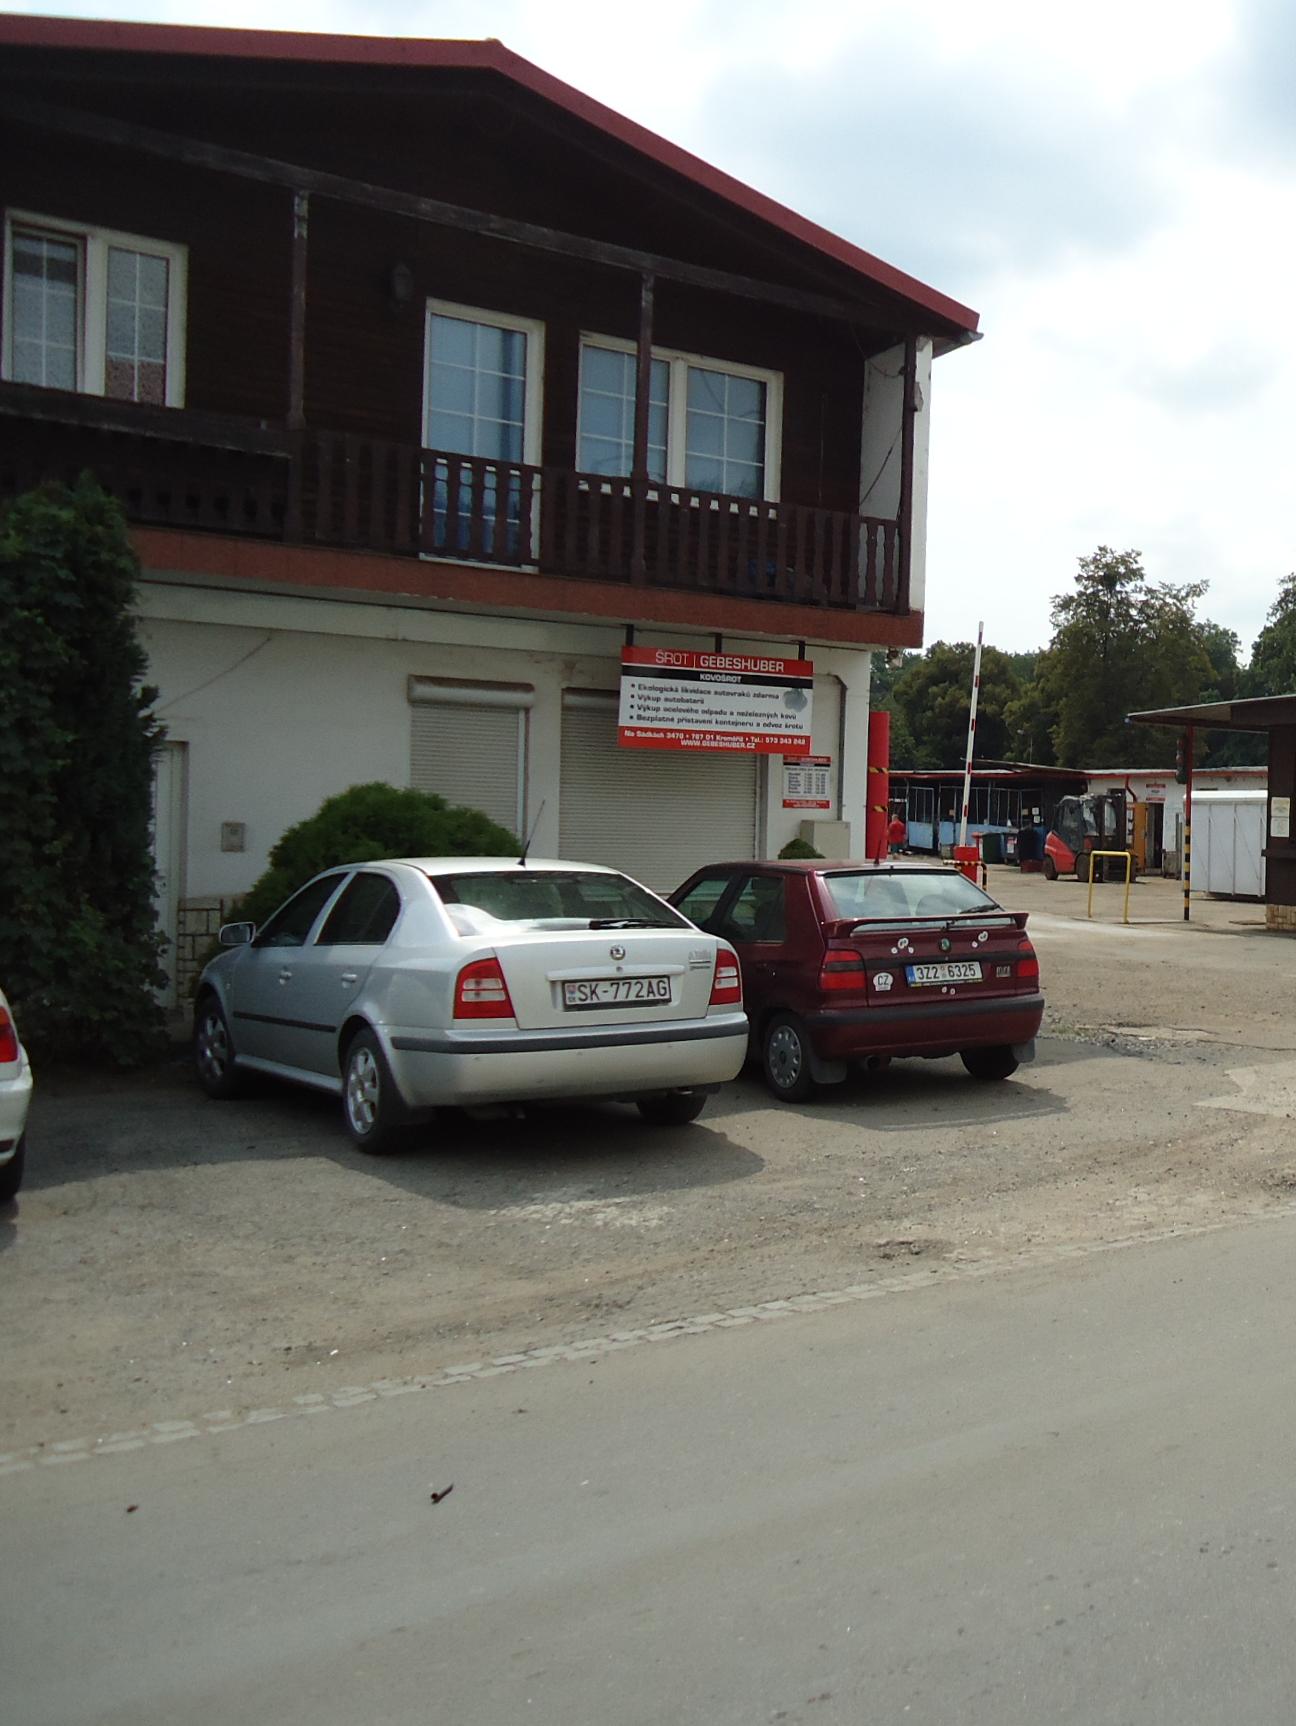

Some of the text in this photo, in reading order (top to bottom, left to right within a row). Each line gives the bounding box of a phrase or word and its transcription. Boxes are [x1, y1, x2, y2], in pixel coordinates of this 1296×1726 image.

[655, 649, 785, 672] ŠROT GEBESHUBER
[700, 673, 742, 683] KOVOŠROT
[638, 683, 679, 693] Ekologická
[681, 686, 711, 695] likvidace
[752, 691, 779, 699] zdarma
[637, 693, 661, 703] Výkup
[637, 703, 660, 713] Výkup
[663, 705, 699, 714] ocelového
[701, 708, 727, 716] odpadu
[715, 718, 754, 727] kontejneru
[763, 721, 782, 729] odvoz
[785, 722, 803, 730] šrotu
[916, 963, 976, 980] 3Z2 6325
[877, 975, 889, 986] CZ
[577, 980, 668, 1002] SK-772AG
